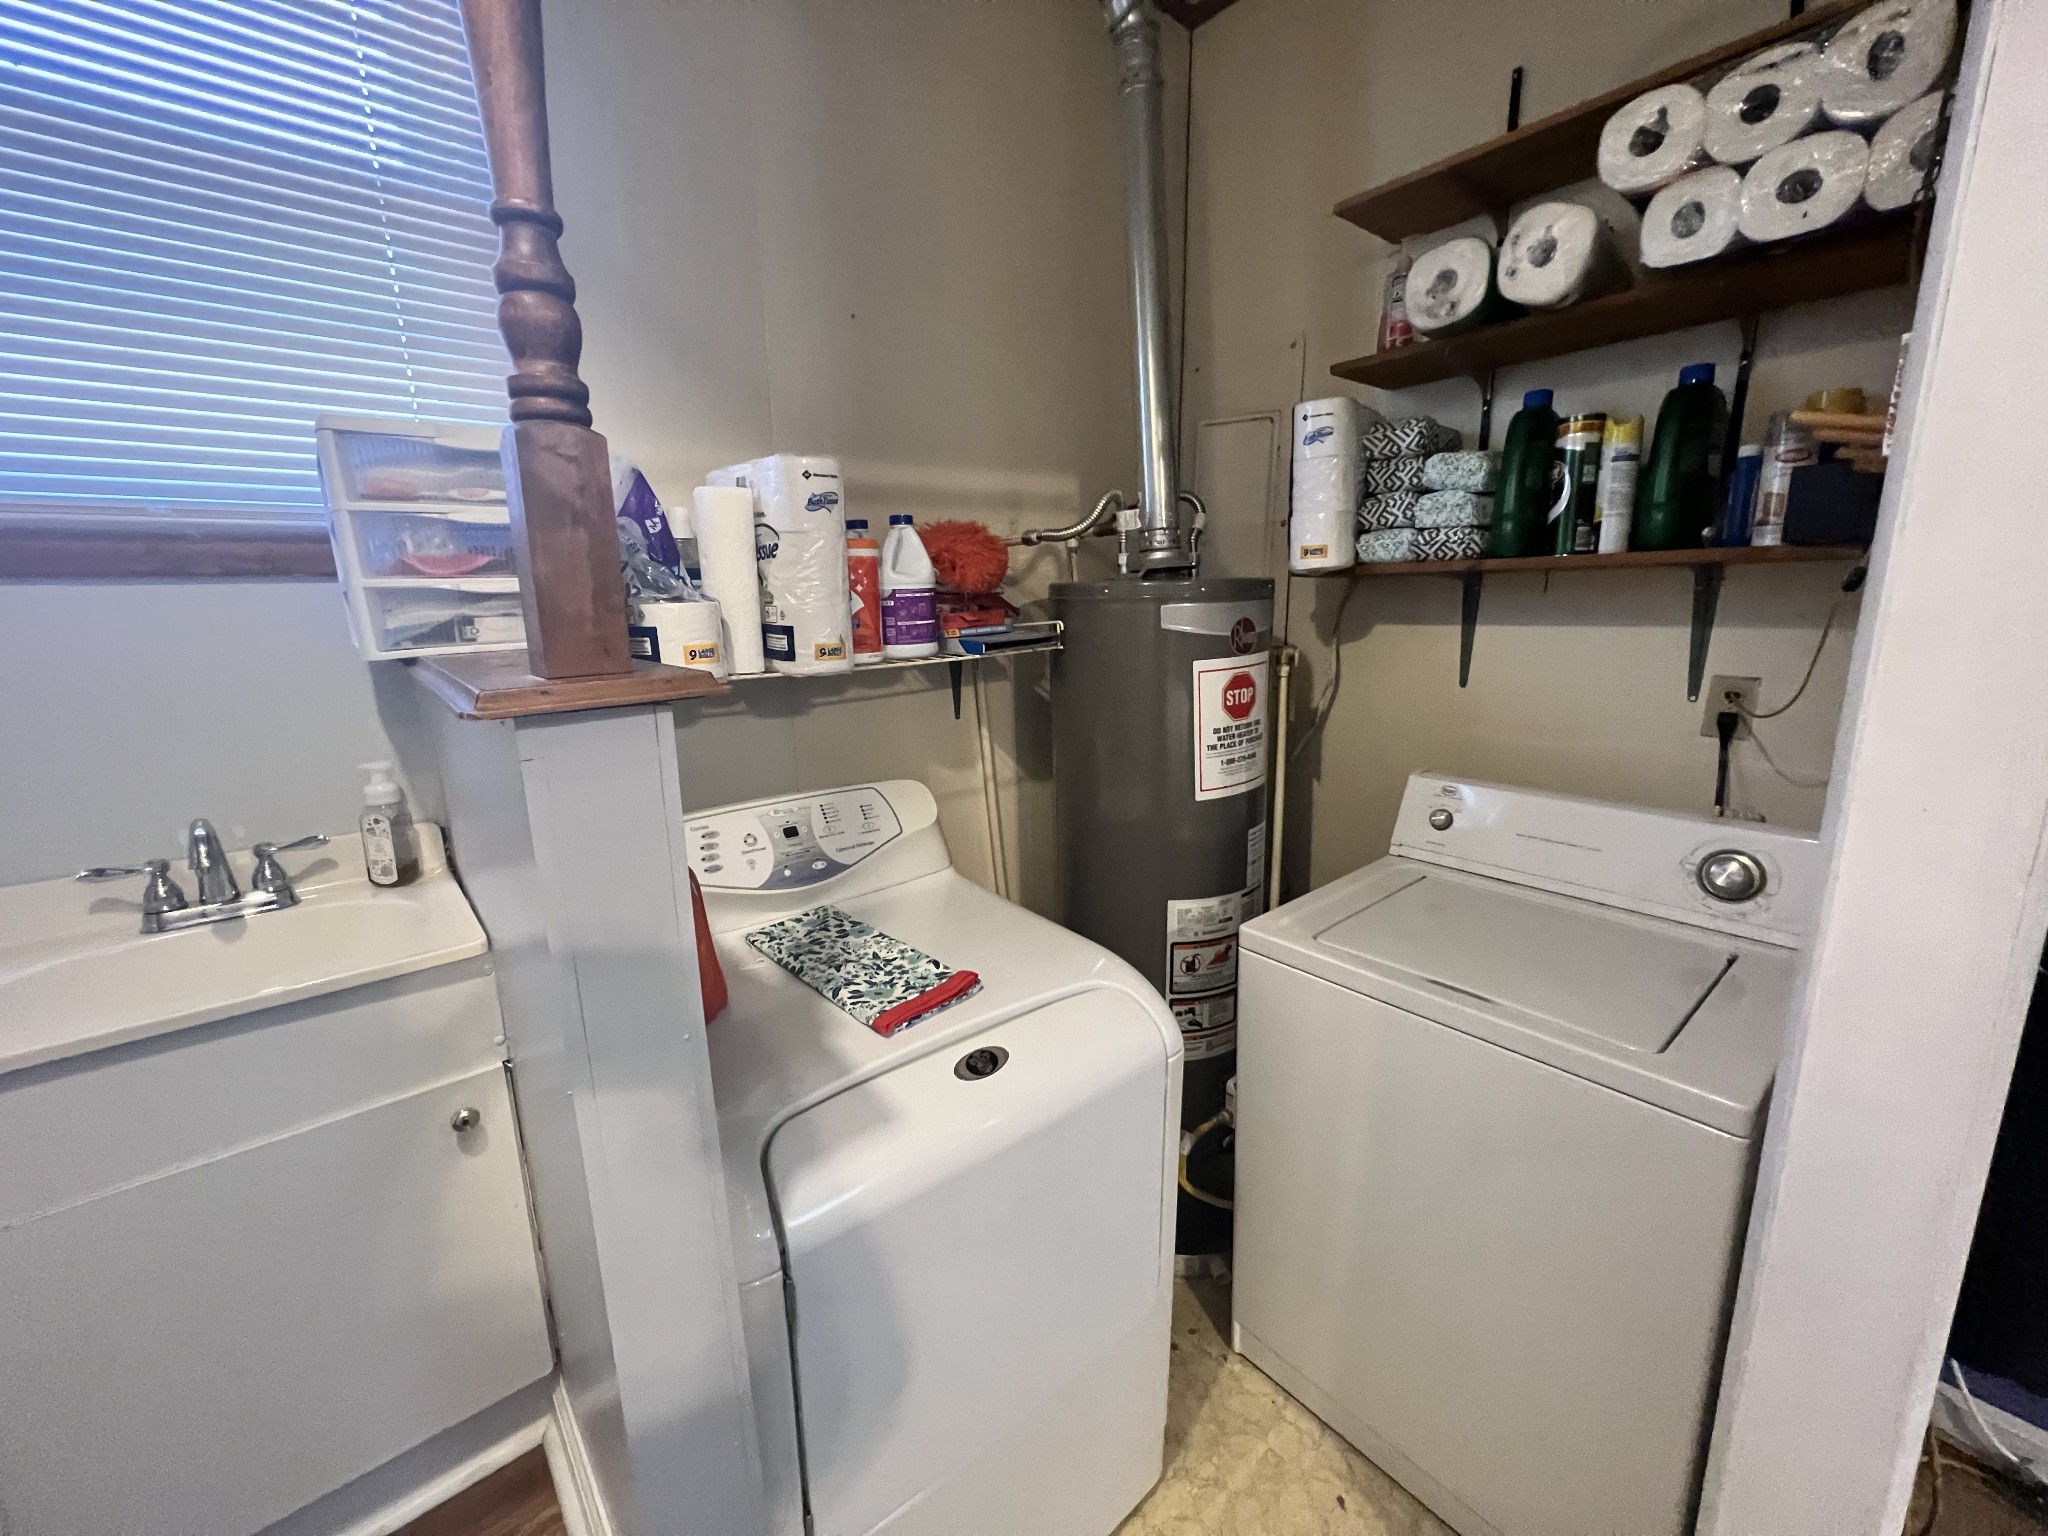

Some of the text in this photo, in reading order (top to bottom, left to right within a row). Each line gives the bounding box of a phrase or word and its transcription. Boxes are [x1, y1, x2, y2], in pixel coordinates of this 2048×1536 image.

[755, 543, 779, 562] ssue
[689, 650, 697, 660] 9
[819, 648, 827, 658] 9
[1226, 687, 1254, 706] STOP
[1212, 727, 1222, 735] DO
[1223, 725, 1234, 734] NOT
[1217, 733, 1236, 742] WATER
[1237, 729, 1254, 739] HEATER
[1207, 743, 1219, 752] THE
[1220, 740, 1238, 750] PLACE
[1238, 738, 1244, 747] OF
